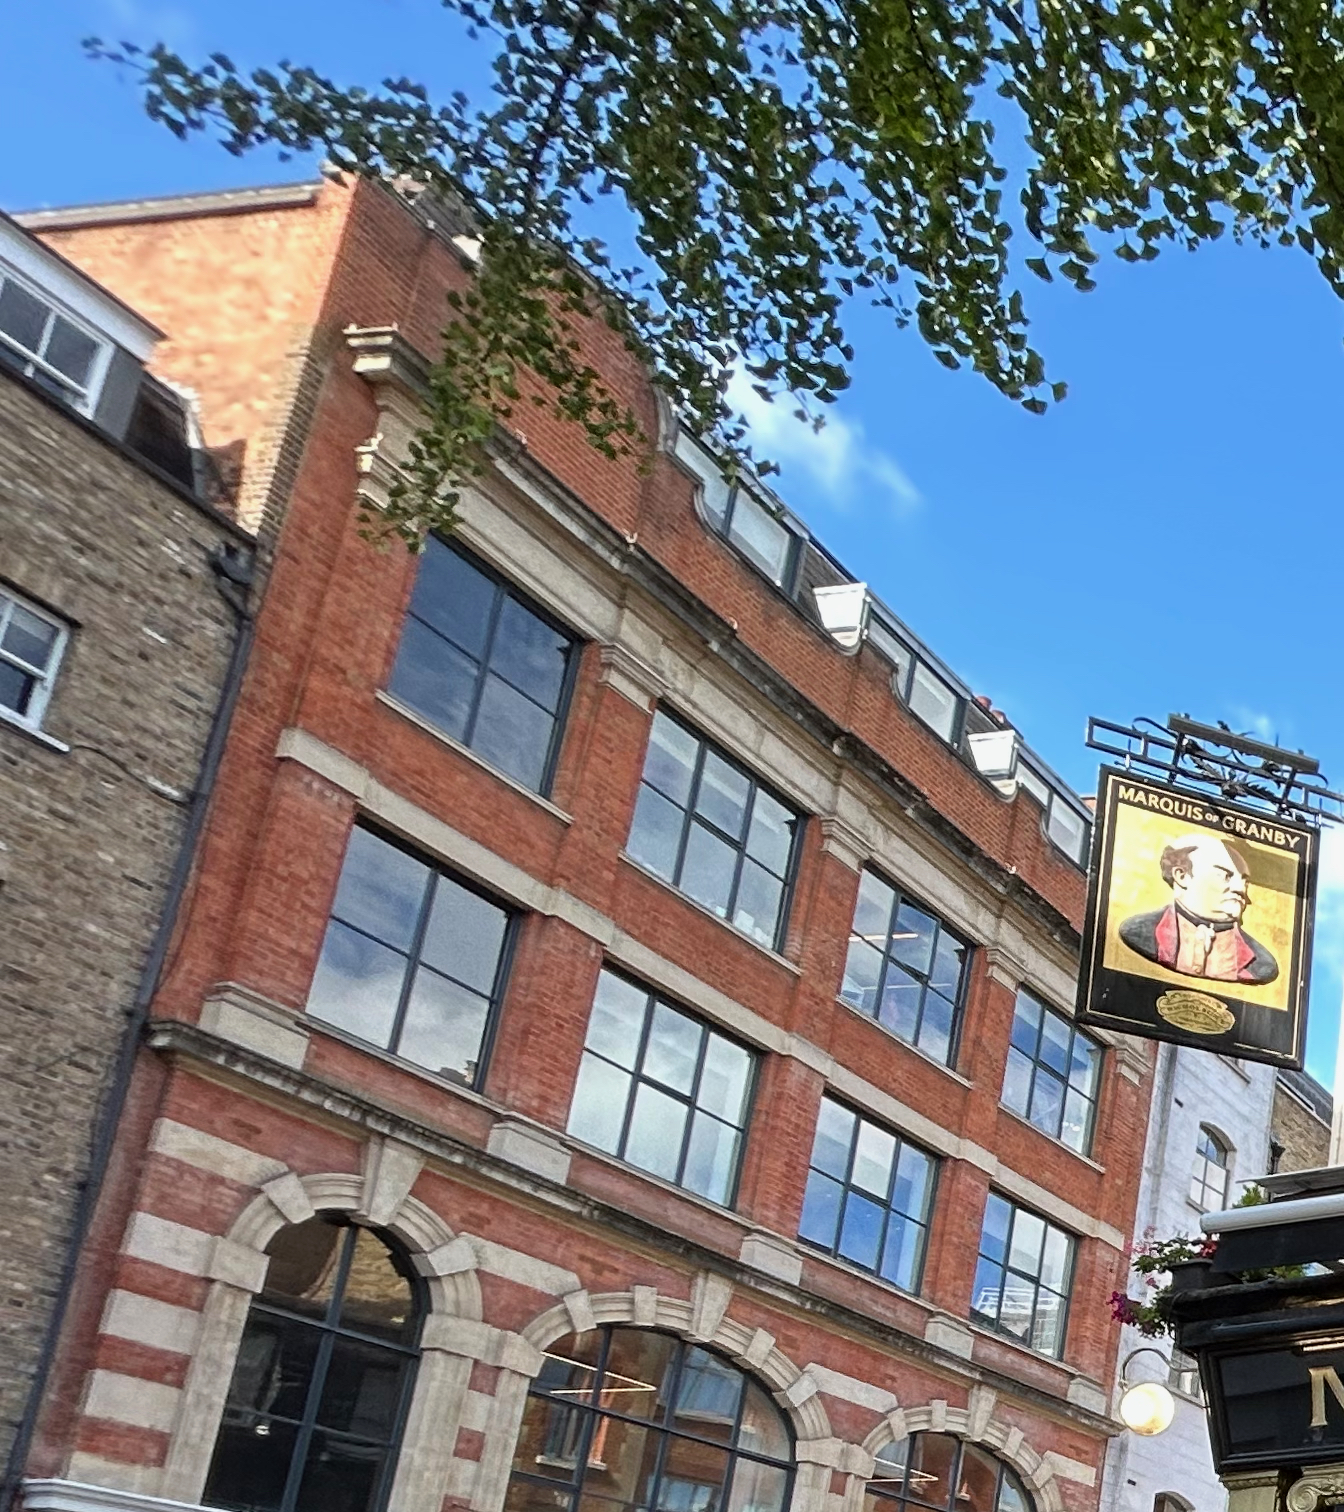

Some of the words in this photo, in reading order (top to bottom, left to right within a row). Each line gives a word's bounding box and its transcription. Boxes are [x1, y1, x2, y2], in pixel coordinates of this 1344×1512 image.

[1118, 785, 1204, 821] MARQUIS
[1205, 812, 1219, 823] OF
[1222, 816, 1301, 849] GRANBY
